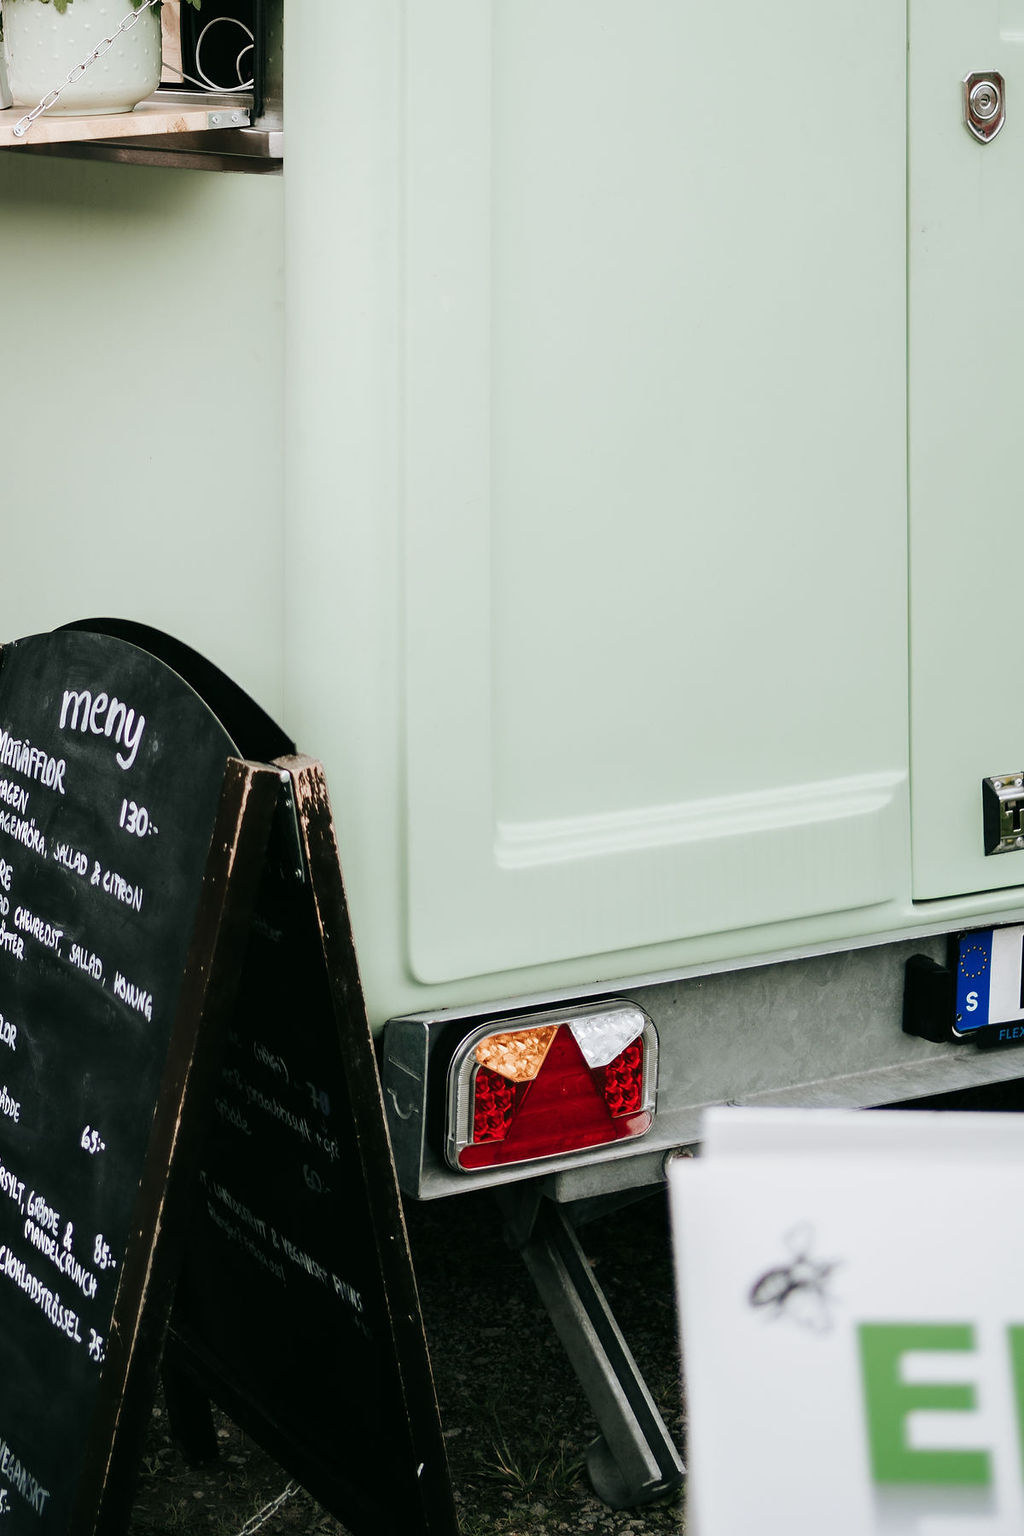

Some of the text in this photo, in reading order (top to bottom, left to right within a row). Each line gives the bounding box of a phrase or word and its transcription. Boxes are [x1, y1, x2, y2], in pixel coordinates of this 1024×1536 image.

[59, 690, 146, 770] meny
[53, 843, 88, 876] SALLAD
[90, 861, 101, 886] &
[103, 870, 143, 912] CITRON
[113, 970, 153, 1023] HONUNG
[965, 991, 979, 1012] S
[27, 1190, 60, 1237] GRÄDDE
[63, 1221, 73, 1252] &
[24, 1218, 97, 1300] MANDELCRUNCH
[856, 1321, 1024, 1485] E
